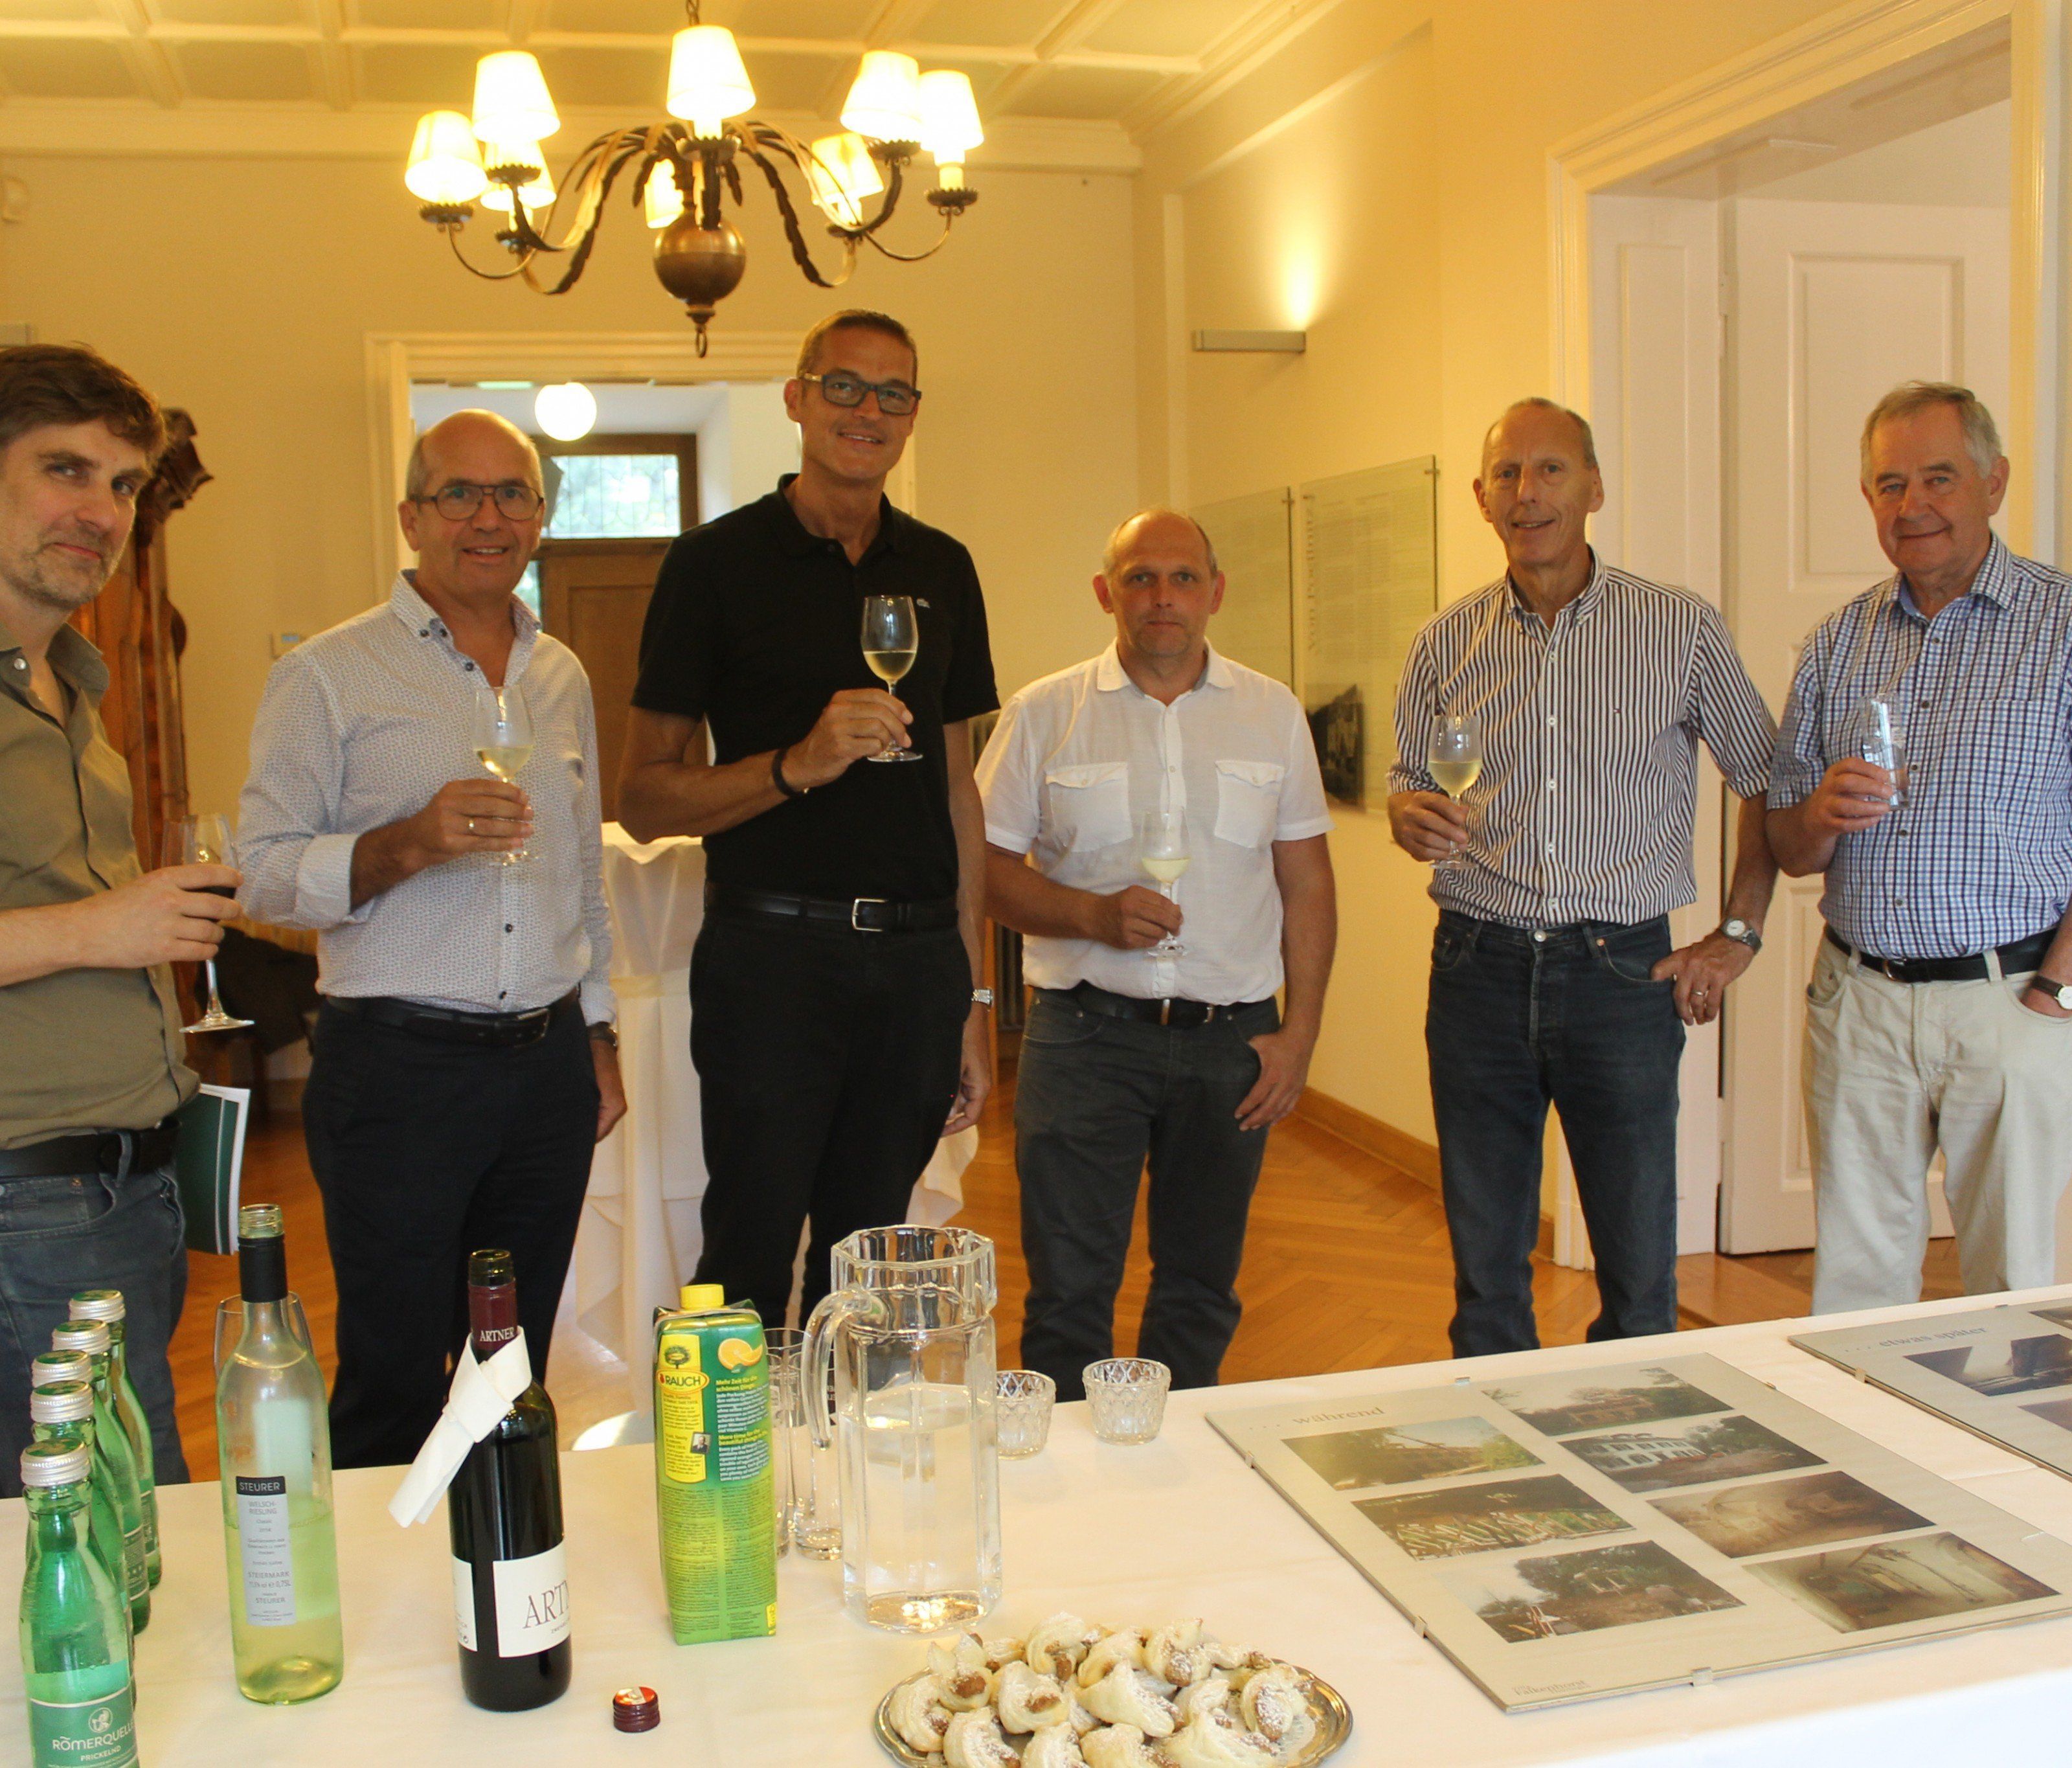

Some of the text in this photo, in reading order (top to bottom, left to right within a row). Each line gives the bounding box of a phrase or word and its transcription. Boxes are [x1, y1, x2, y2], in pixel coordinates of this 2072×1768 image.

[479, 1326, 515, 1342] ARTNER
[1878, 1335, 1931, 1348] etwas
[1933, 1327, 1988, 1340] später
[665, 1375, 701, 1387] RAUCH
[1292, 1406, 1385, 1424] während
[239, 1481, 281, 1491] STEURER
[80, 1745, 122, 1761] PRICKELND
